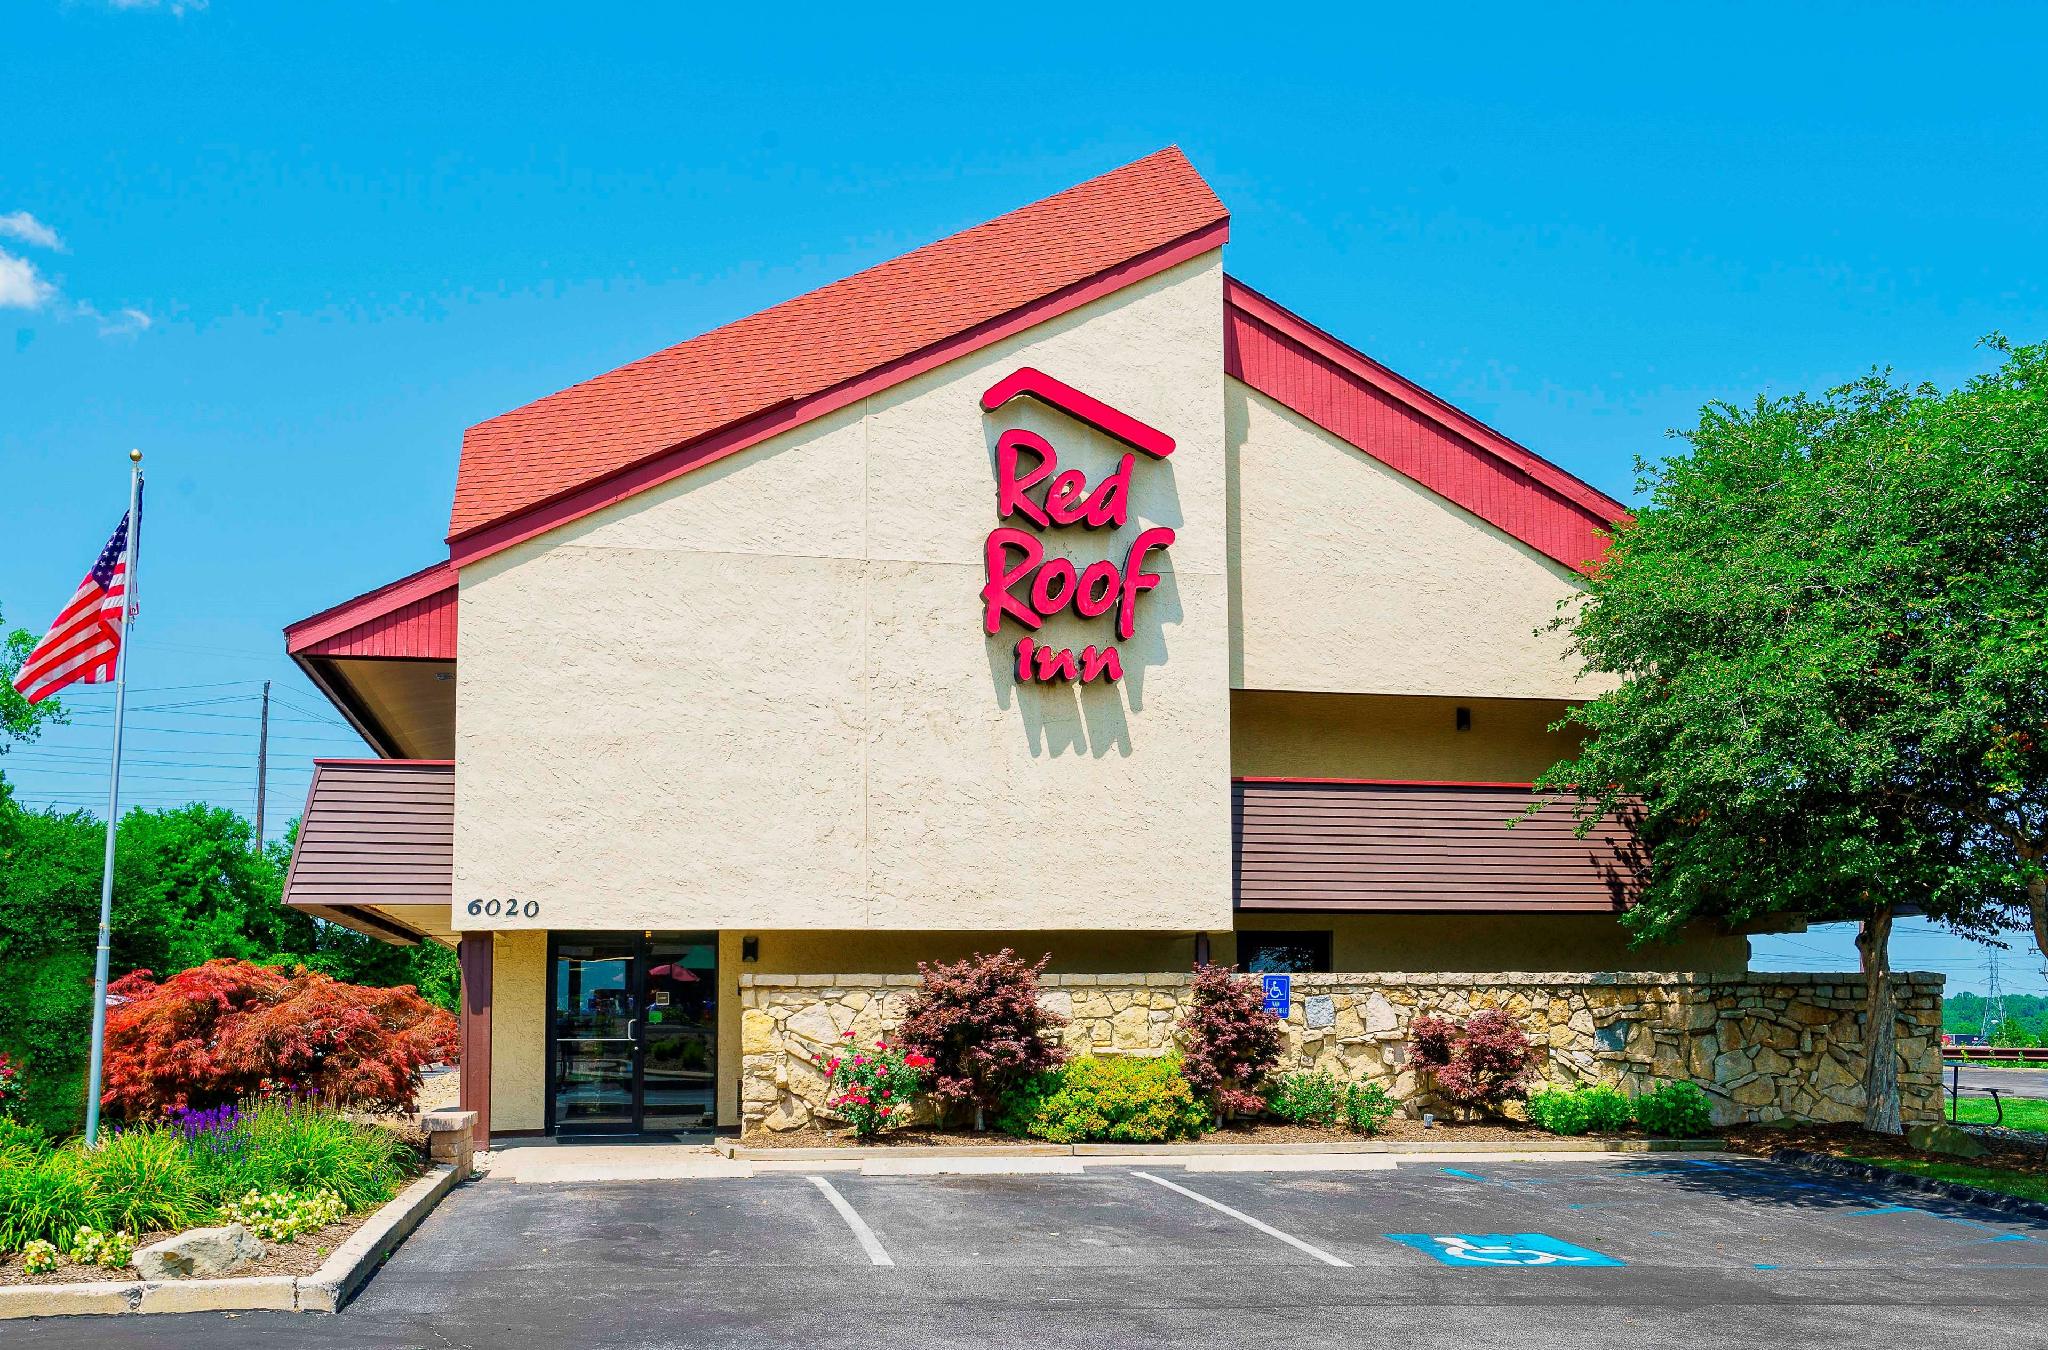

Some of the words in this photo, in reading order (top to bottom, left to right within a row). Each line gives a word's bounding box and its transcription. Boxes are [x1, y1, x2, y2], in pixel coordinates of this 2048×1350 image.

[996, 429, 1135, 530] Red
[981, 528, 1175, 640] Roof
[1015, 636, 1123, 683] Inn
[467, 898, 540, 918] 6020
